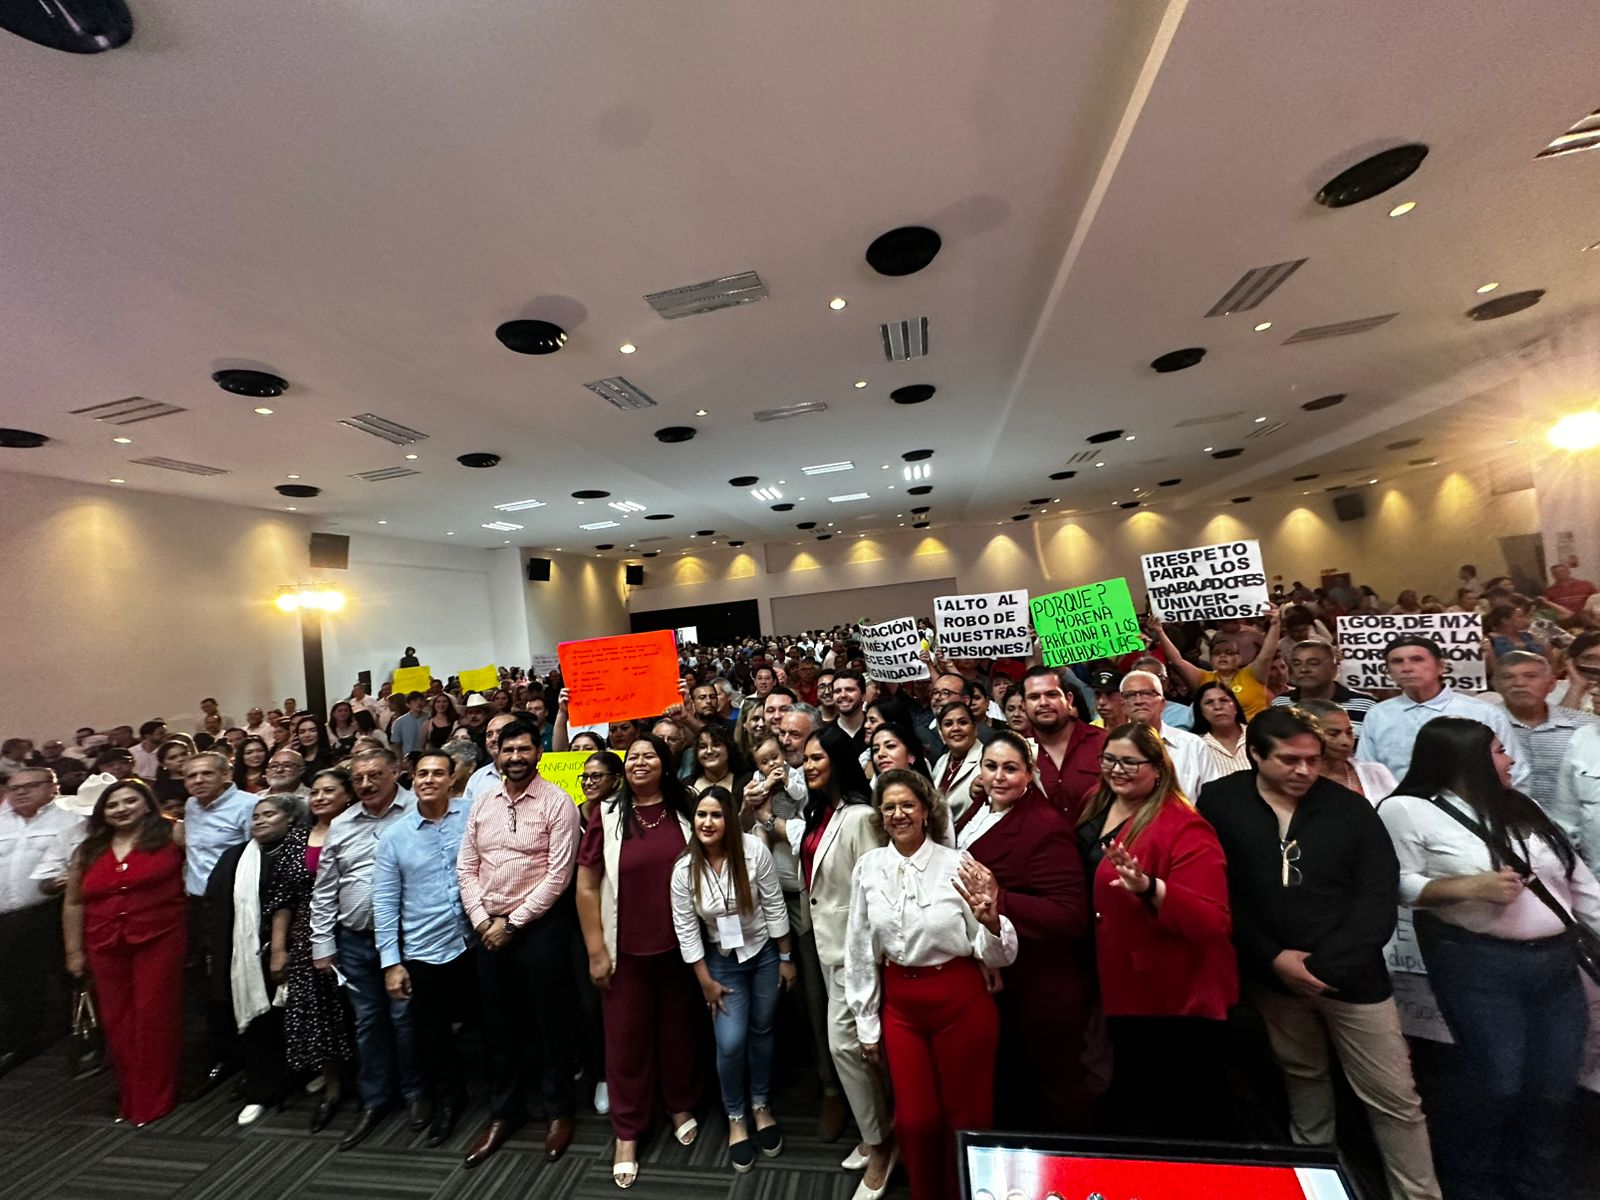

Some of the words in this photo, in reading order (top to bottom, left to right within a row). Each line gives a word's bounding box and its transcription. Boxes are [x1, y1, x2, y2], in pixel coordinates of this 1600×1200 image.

[1146, 543, 1247, 569] ¡RESPETO
[1149, 565, 1199, 582] PARA
[1210, 557, 1250, 576] LOS
[937, 598, 987, 611] ¡ALTO
[998, 594, 1018, 606] AL
[1157, 592, 1239, 611] UNIVER-
[944, 615, 990, 628] ROBO
[994, 611, 1016, 624] DE
[1055, 606, 1113, 632] MORENA
[1164, 604, 1262, 622] SITARIOS!
[1440, 614, 1482, 629] MX
[939, 626, 1027, 644] NUESTRAS
[1101, 624, 1111, 638] A
[1115, 618, 1137, 635] LOS
[865, 634, 917, 653] MÉXICO
[1451, 631, 1481, 644] LA
[941, 641, 1030, 657] PENSIONES!
[1043, 641, 1108, 667] JUBILADOS
[872, 665, 922, 680] GNIDAD!
